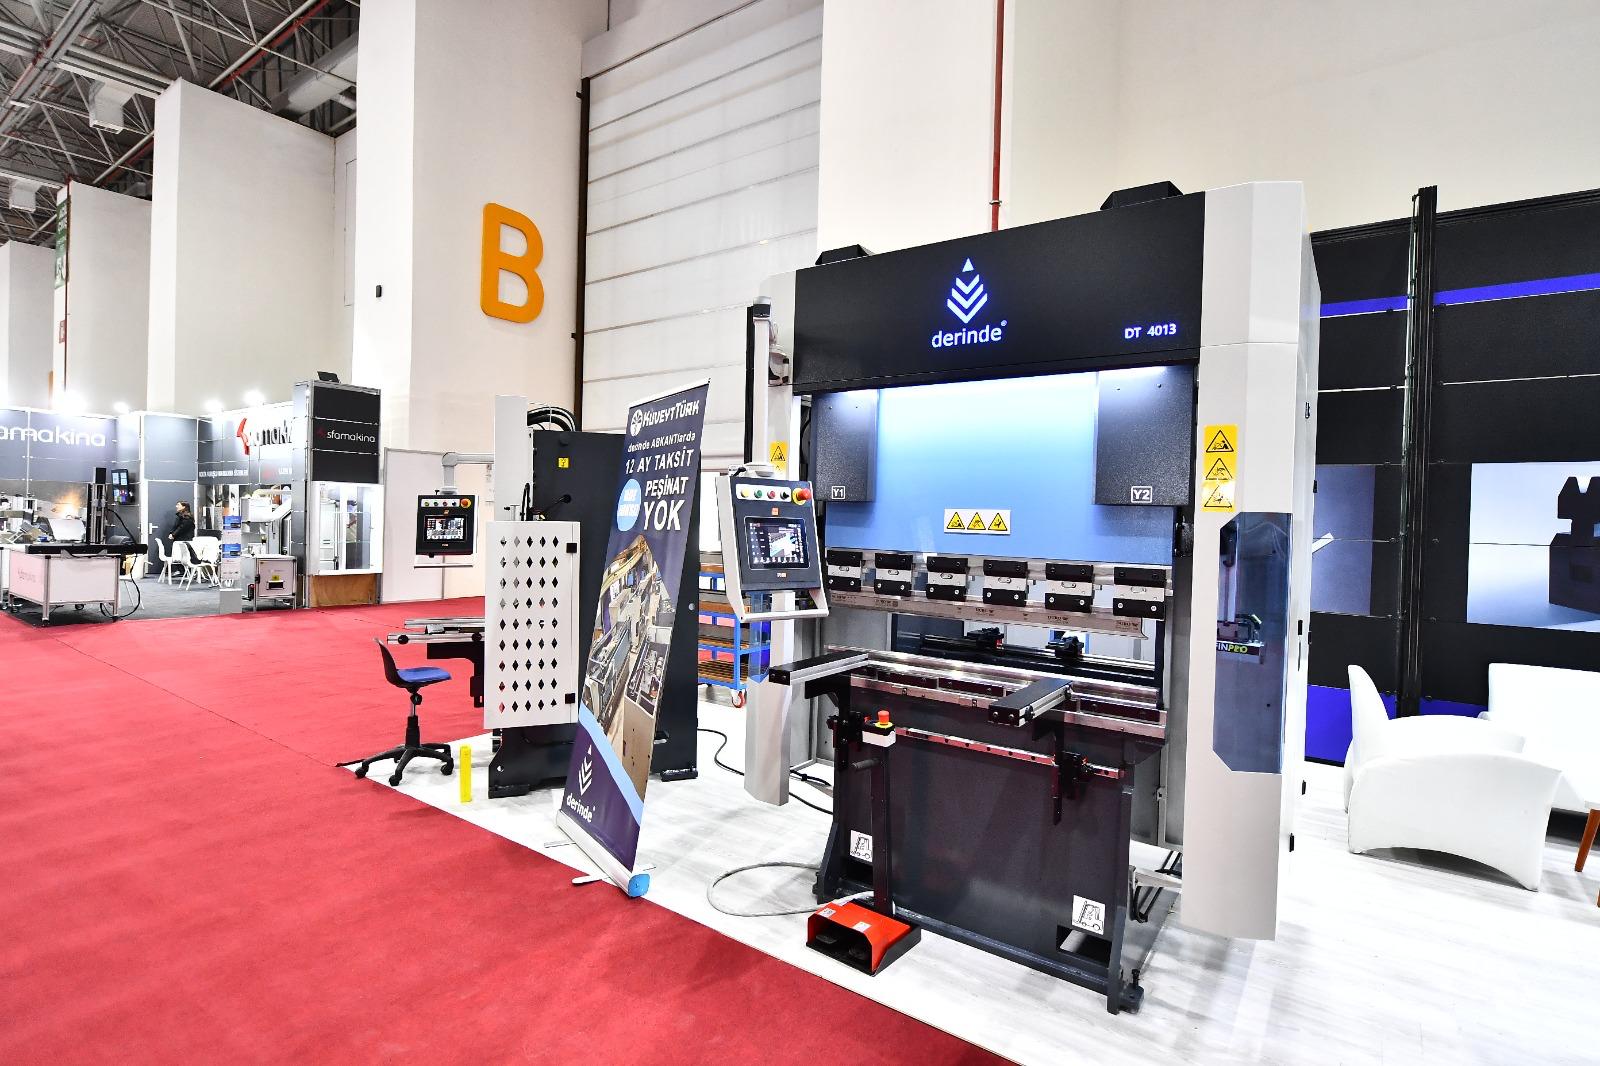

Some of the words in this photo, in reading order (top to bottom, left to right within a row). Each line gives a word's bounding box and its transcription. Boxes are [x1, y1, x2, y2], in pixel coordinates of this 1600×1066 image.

[480, 202, 545, 324] B
[931, 323, 1002, 348] derinde
[1124, 326, 1142, 339] DT
[1146, 323, 1177, 337] 4013
[326, 429, 376, 443] sfamakina
[625, 458, 636, 475] 12
[636, 455, 653, 473] AY
[654, 445, 695, 471] TAKSİT
[644, 474, 689, 500] PEŞİNAT
[833, 488, 844, 498] Y1
[1133, 489, 1150, 500] Y2
[643, 499, 686, 531] YOK
[566, 792, 593, 823] derinde
